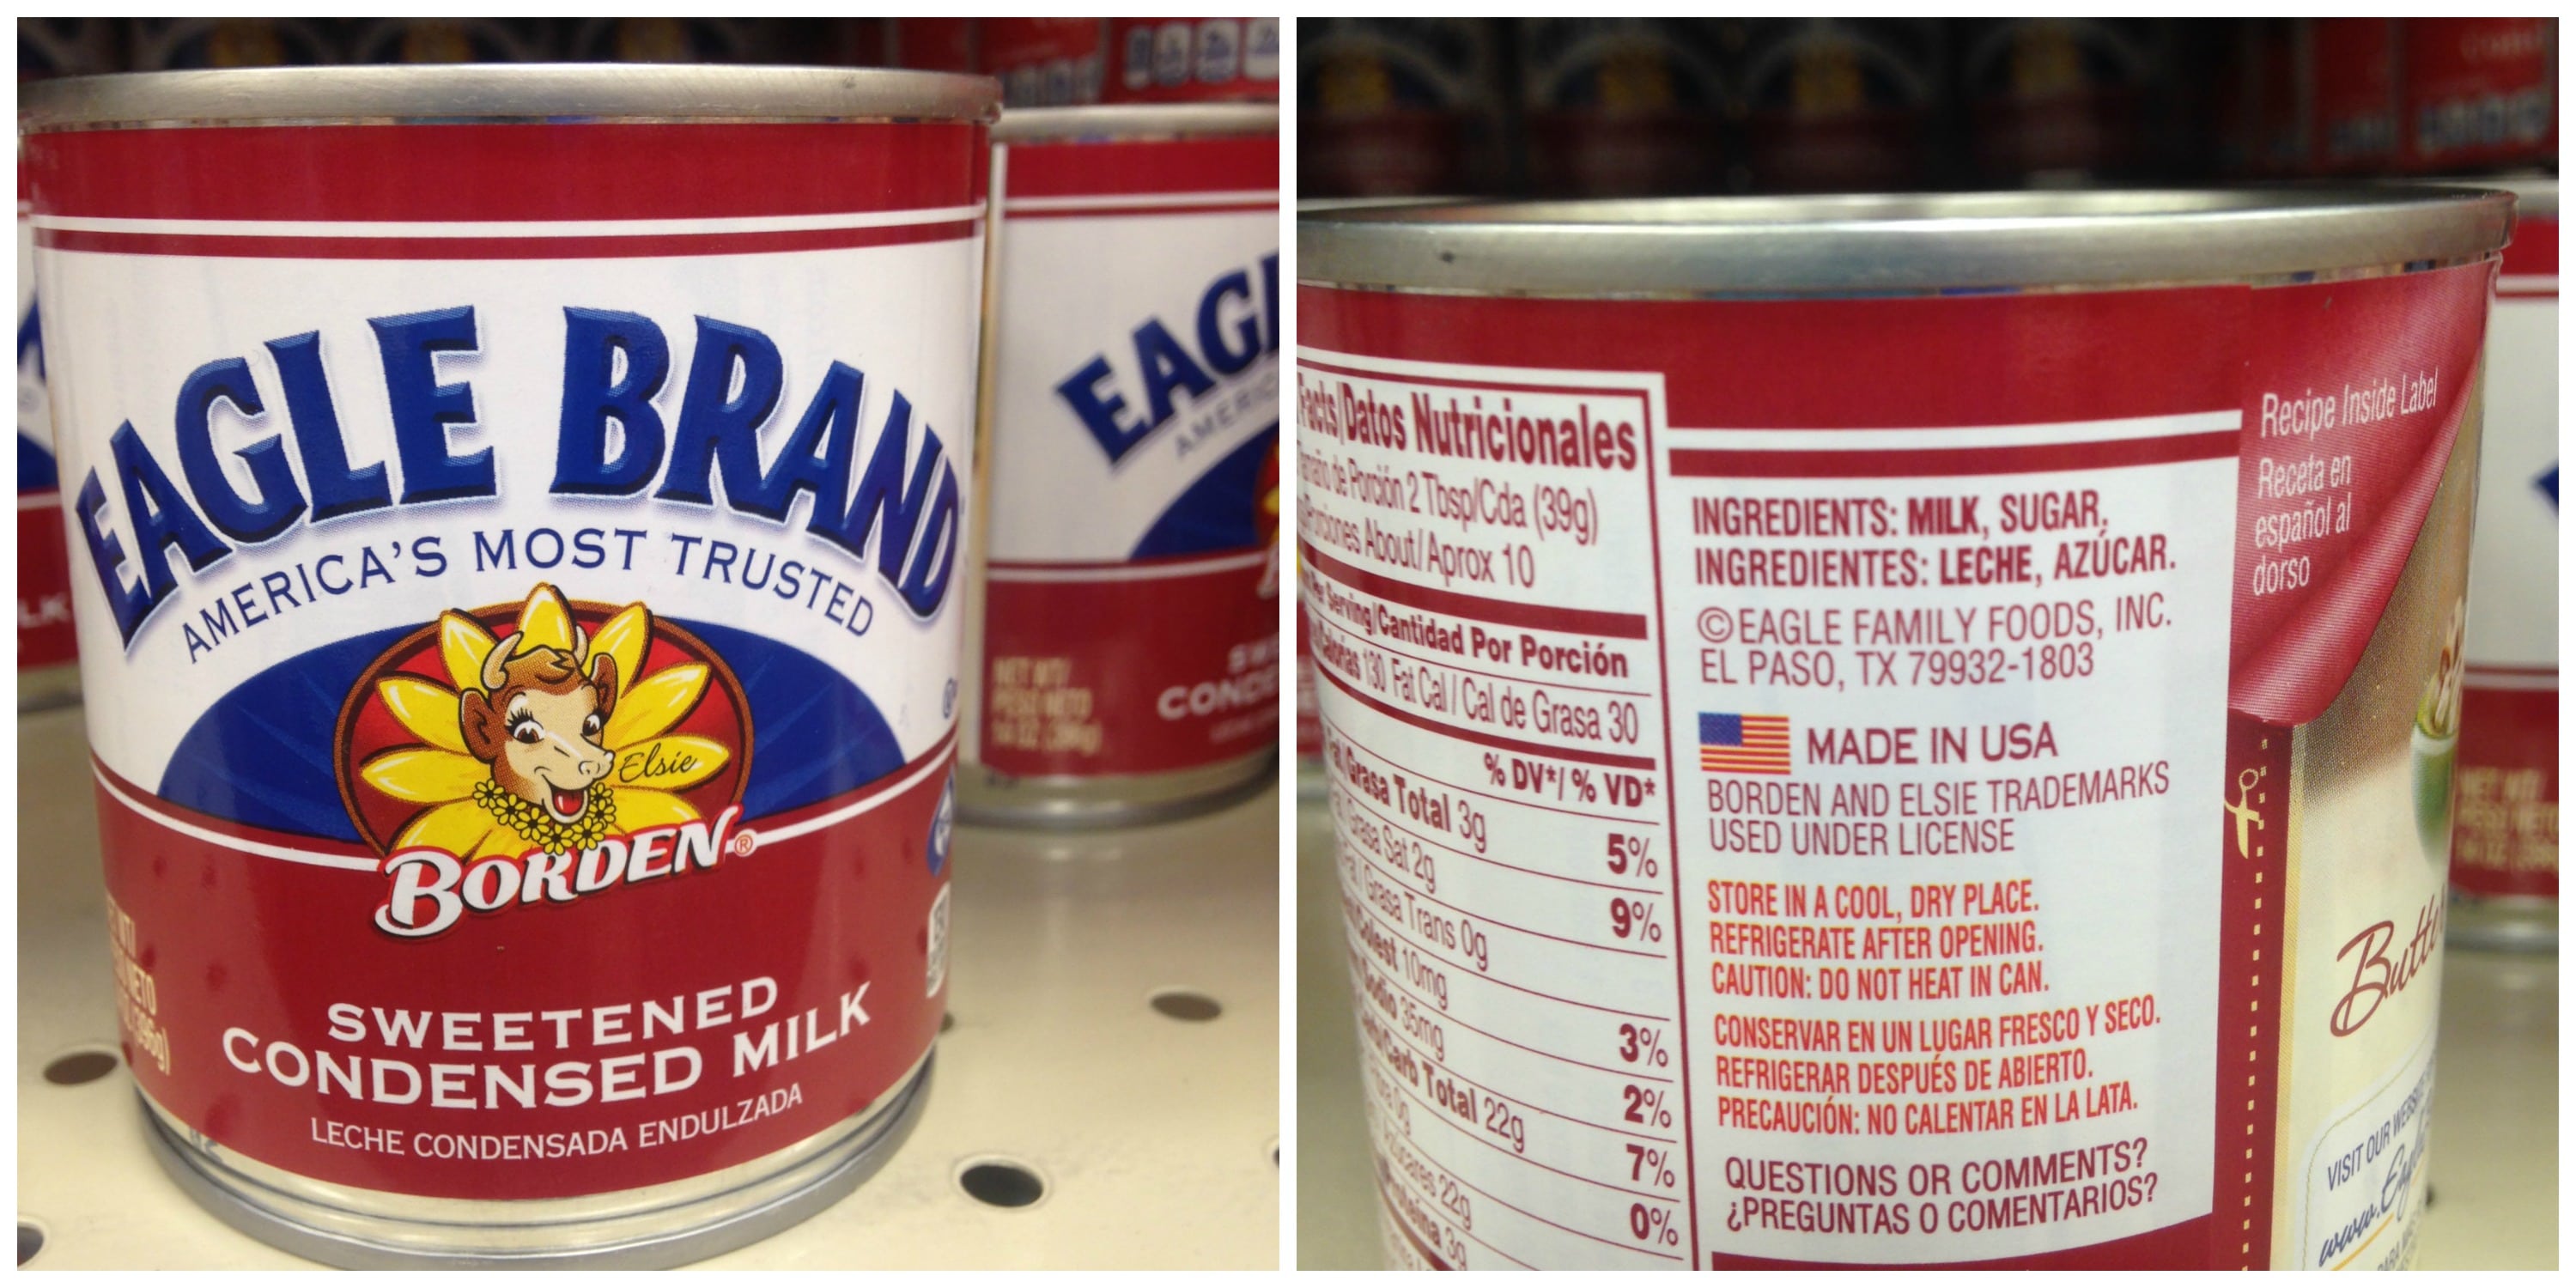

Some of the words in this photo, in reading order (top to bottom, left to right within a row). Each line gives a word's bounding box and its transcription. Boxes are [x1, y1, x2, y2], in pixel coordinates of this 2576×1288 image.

[1054, 247, 1279, 465] EAG
[1411, 392, 1637, 471] Nutricionales
[2261, 387, 2336, 440] Recipe
[2342, 383, 2397, 426] Inside
[2400, 367, 2439, 416] Label
[74, 305, 497, 653] EAGLE
[549, 306, 959, 618] BRAND
[1332, 454, 1347, 497] de
[1347, 457, 1405, 511] Porción
[1406, 471, 1421, 513] 2
[1421, 471, 1528, 533] Tbsp/Cda
[1534, 483, 1599, 547] (39g)
[2257, 452, 2326, 500] Receta
[2330, 454, 2352, 485] en
[1692, 496, 1898, 537] INGREDIENTS:
[1907, 495, 1990, 540] MILK,
[2000, 489, 2109, 533] SUGAR.
[2254, 495, 2331, 551] español
[2335, 493, 2352, 532] al
[1427, 529, 1494, 586] Aprox
[1502, 543, 1535, 588] 10
[1695, 547, 1929, 588] INGREDIENTES:
[1939, 544, 2043, 587] LECHE,
[2053, 531, 2177, 581] AZÚCAR.
[2252, 555, 2311, 597] dorso
[182, 536, 448, 664] AMERICA'S
[475, 528, 647, 572] MOST
[671, 534, 874, 637] TRUSTED
[1853, 606, 1977, 645] FAMILY
[1987, 600, 2104, 641] FOODS,
[2115, 592, 2172, 632] INC.
[1471, 626, 1512, 664] Por
[1520, 634, 1630, 678] Porción
[1699, 648, 1737, 684] EL
[1748, 650, 1846, 692] PASO,
[1856, 650, 1899, 686] TX
[1910, 641, 2095, 686] 79932-1803
[1392, 658, 1417, 704] Fat
[1419, 666, 1448, 713] Cal
[1461, 676, 1494, 724] Cal
[1501, 683, 1526, 729] de
[1532, 689, 1602, 740] Grasa
[1607, 700, 1639, 744] 30
[619, 743, 697, 784] Elsie
[1807, 727, 1918, 765] MADE
[1929, 726, 1968, 764] IN
[1981, 720, 2059, 762] USA
[1393, 774, 1452, 833] Total
[1457, 799, 1487, 854] 3g
[1707, 778, 1822, 817] BORDEN
[1831, 782, 1889, 817] AND
[1900, 781, 1978, 817] ELSIE
[1987, 760, 2170, 814] TRADEMARKS
[1382, 824, 1410, 873] Sat
[1412, 841, 1436, 894] 2g
[1607, 833, 1659, 879] 5%
[1709, 817, 1782, 854] USED
[1791, 821, 1889, 856] UNDER
[1899, 817, 2016, 856] LICENSE
[374, 807, 740, 938] BORDEN
[1707, 879, 1777, 917] STORE
[1784, 884, 1806, 919] IN
[1814, 884, 1829, 919] A
[1835, 884, 1903, 924] COOL,
[1910, 884, 1956, 919] DRY
[1963, 878, 2040, 916] PLACE.
[1404, 890, 1456, 950] Trans
[1461, 919, 1488, 972] 0g
[1609, 897, 1662, 943] 9%
[1710, 920, 1856, 960] REFRIGERATE
[1862, 926, 1932, 960] AFTER
[1940, 920, 2044, 958] OPENING.
[1402, 947, 1448, 1012] 10mg
[1711, 961, 1813, 999] CAUTION:
[1819, 967, 1850, 1001] DO
[1857, 967, 1902, 1000] NOT
[1908, 967, 1963, 1000] HEAT
[1970, 963, 1993, 998] IN
[1998, 960, 2050, 996] CAN.
[327, 975, 778, 1052] SWEETENED
[1400, 996, 1444, 1063] 35mg
[1714, 1013, 1841, 1053] CONSERVAR
[1848, 1019, 1875, 1054] EN
[1881, 1019, 1913, 1054] UN
[1919, 1017, 1993, 1053] LUGAR
[1998, 1008, 2080, 1048] FRESCO
[2086, 1005, 2100, 1037] Y
[2105, 993, 2161, 1033] SECO.
[222, 1027, 702, 1109] CONDENSED
[733, 981, 872, 1078] MILK
[1618, 1022, 1669, 1068] 3%
[1716, 1054, 1850, 1094] REFRIGERAR
[1856, 1054, 1958, 1095] DESPUÉS
[1964, 1059, 1992, 1092] DE
[1997, 1047, 2093, 1088] ABIERTO.
[311, 1117, 404, 1156] LECHE
[414, 1127, 628, 1160] CONDENSADA
[639, 1082, 803, 1148] ENDULZADA
[1421, 1060, 1478, 1125] Total
[1483, 1096, 1525, 1154] 22g
[1622, 1084, 1672, 1129] 2%
[1717, 1095, 1860, 1135] PRECAUCIÓN:
[1867, 1102, 1897, 1136] NO
[1905, 1097, 2014, 1135] CALENTAR
[2020, 1093, 2048, 1127] EN
[2054, 1090, 2080, 1124] LA
[2086, 1080, 2138, 1118] LATA.
[1625, 1143, 1676, 1189] 7%
[1724, 1155, 1900, 1197] QUESTIONS
[1908, 1163, 1951, 1196] OR
[1961, 1137, 2148, 1193] COMMENTS?
[2327, 1142, 2364, 1191] VISIT
[2366, 1119, 2391, 1164] OUR
[1438, 1173, 1472, 1231] 22g
[1630, 1202, 1680, 1248] 0%
[1726, 1195, 1911, 1235] ¿PREGUNTAS
[1919, 1202, 1940, 1234] O
[1947, 1172, 2159, 1233] COMENTARIOS?
